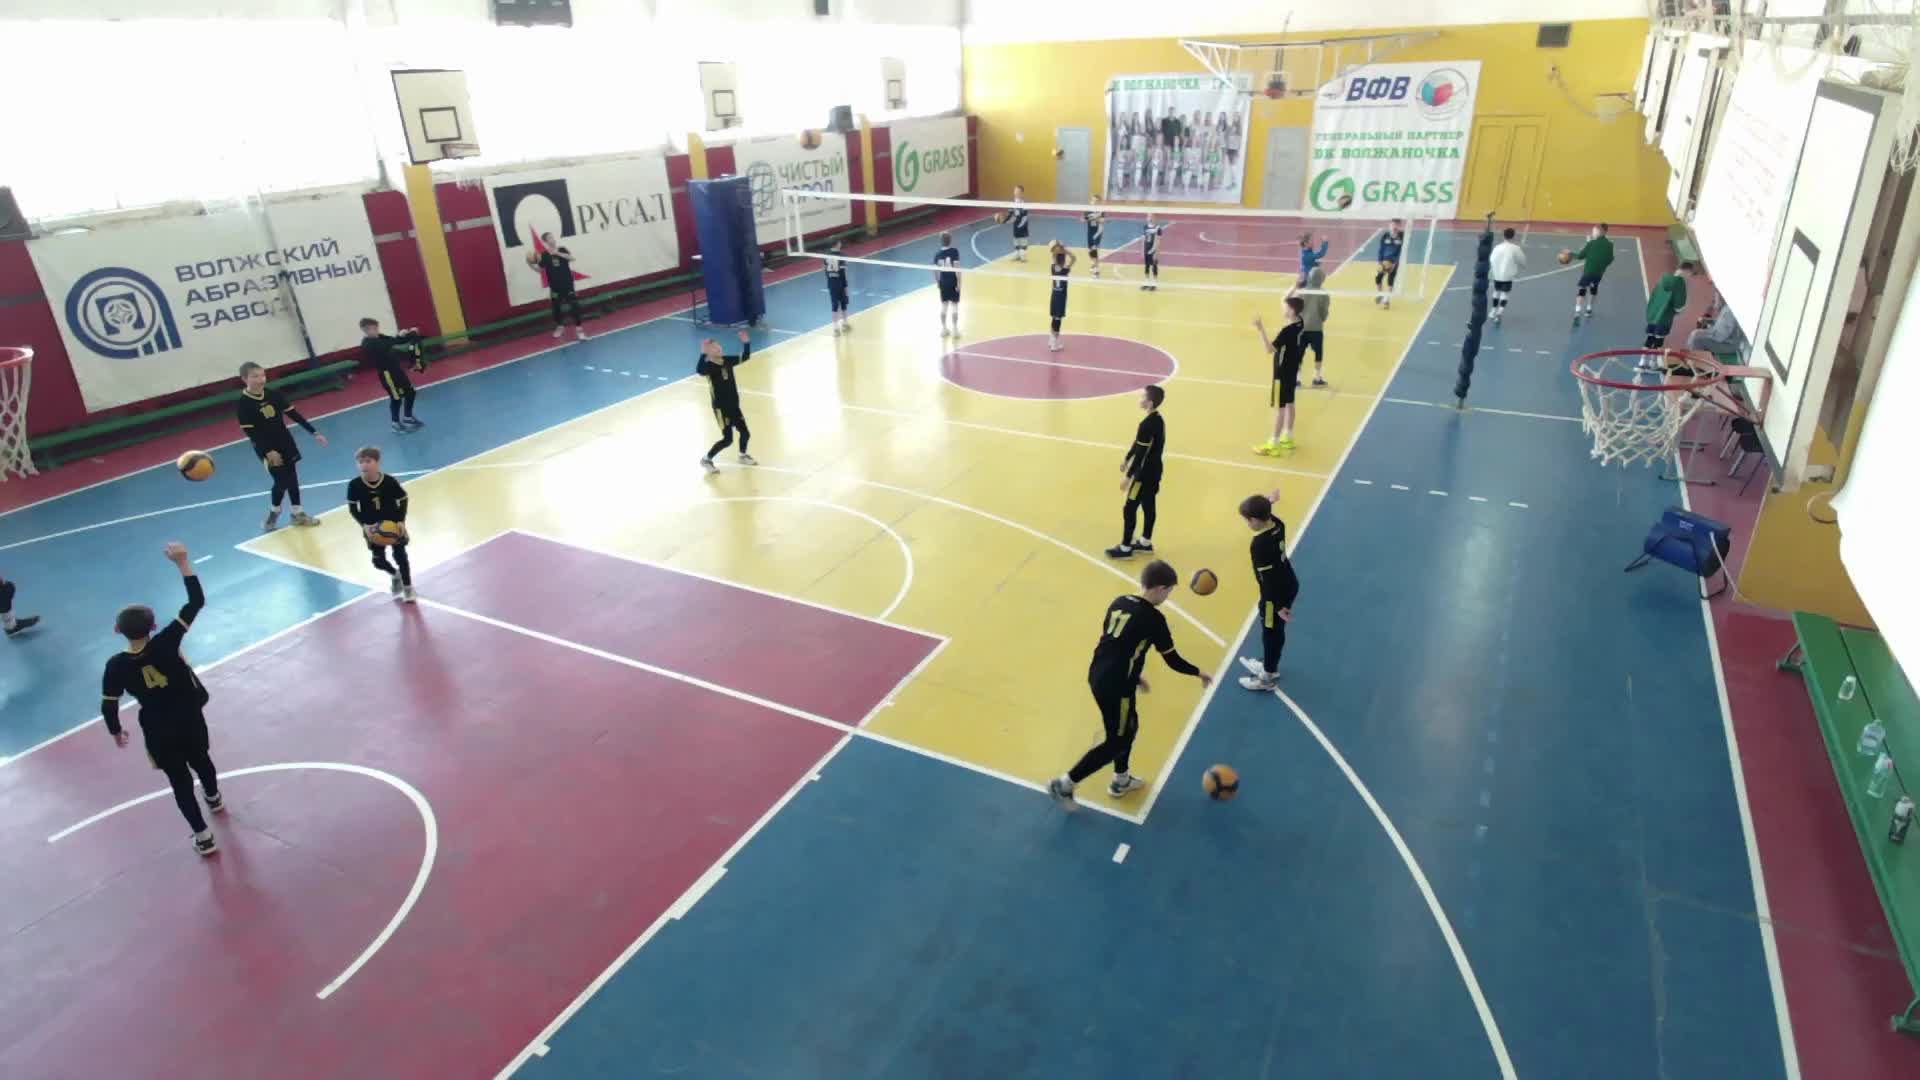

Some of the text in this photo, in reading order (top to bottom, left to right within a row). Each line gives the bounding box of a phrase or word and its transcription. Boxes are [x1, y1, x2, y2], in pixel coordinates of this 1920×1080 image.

[1345, 76, 1411, 102] ВФВ
[923, 144, 965, 174] GRASS
[1341, 147, 1460, 159] ВОЛЖАНОЧКА
[779, 152, 844, 184] ЧИСТЫЙ
[1362, 180, 1455, 204] GRASS
[576, 193, 667, 235] РУСАЛ
[175, 237, 341, 283] ВОЛЖСКИЙ
[259, 404, 276, 419] 10
[141, 664, 169, 689] 4
